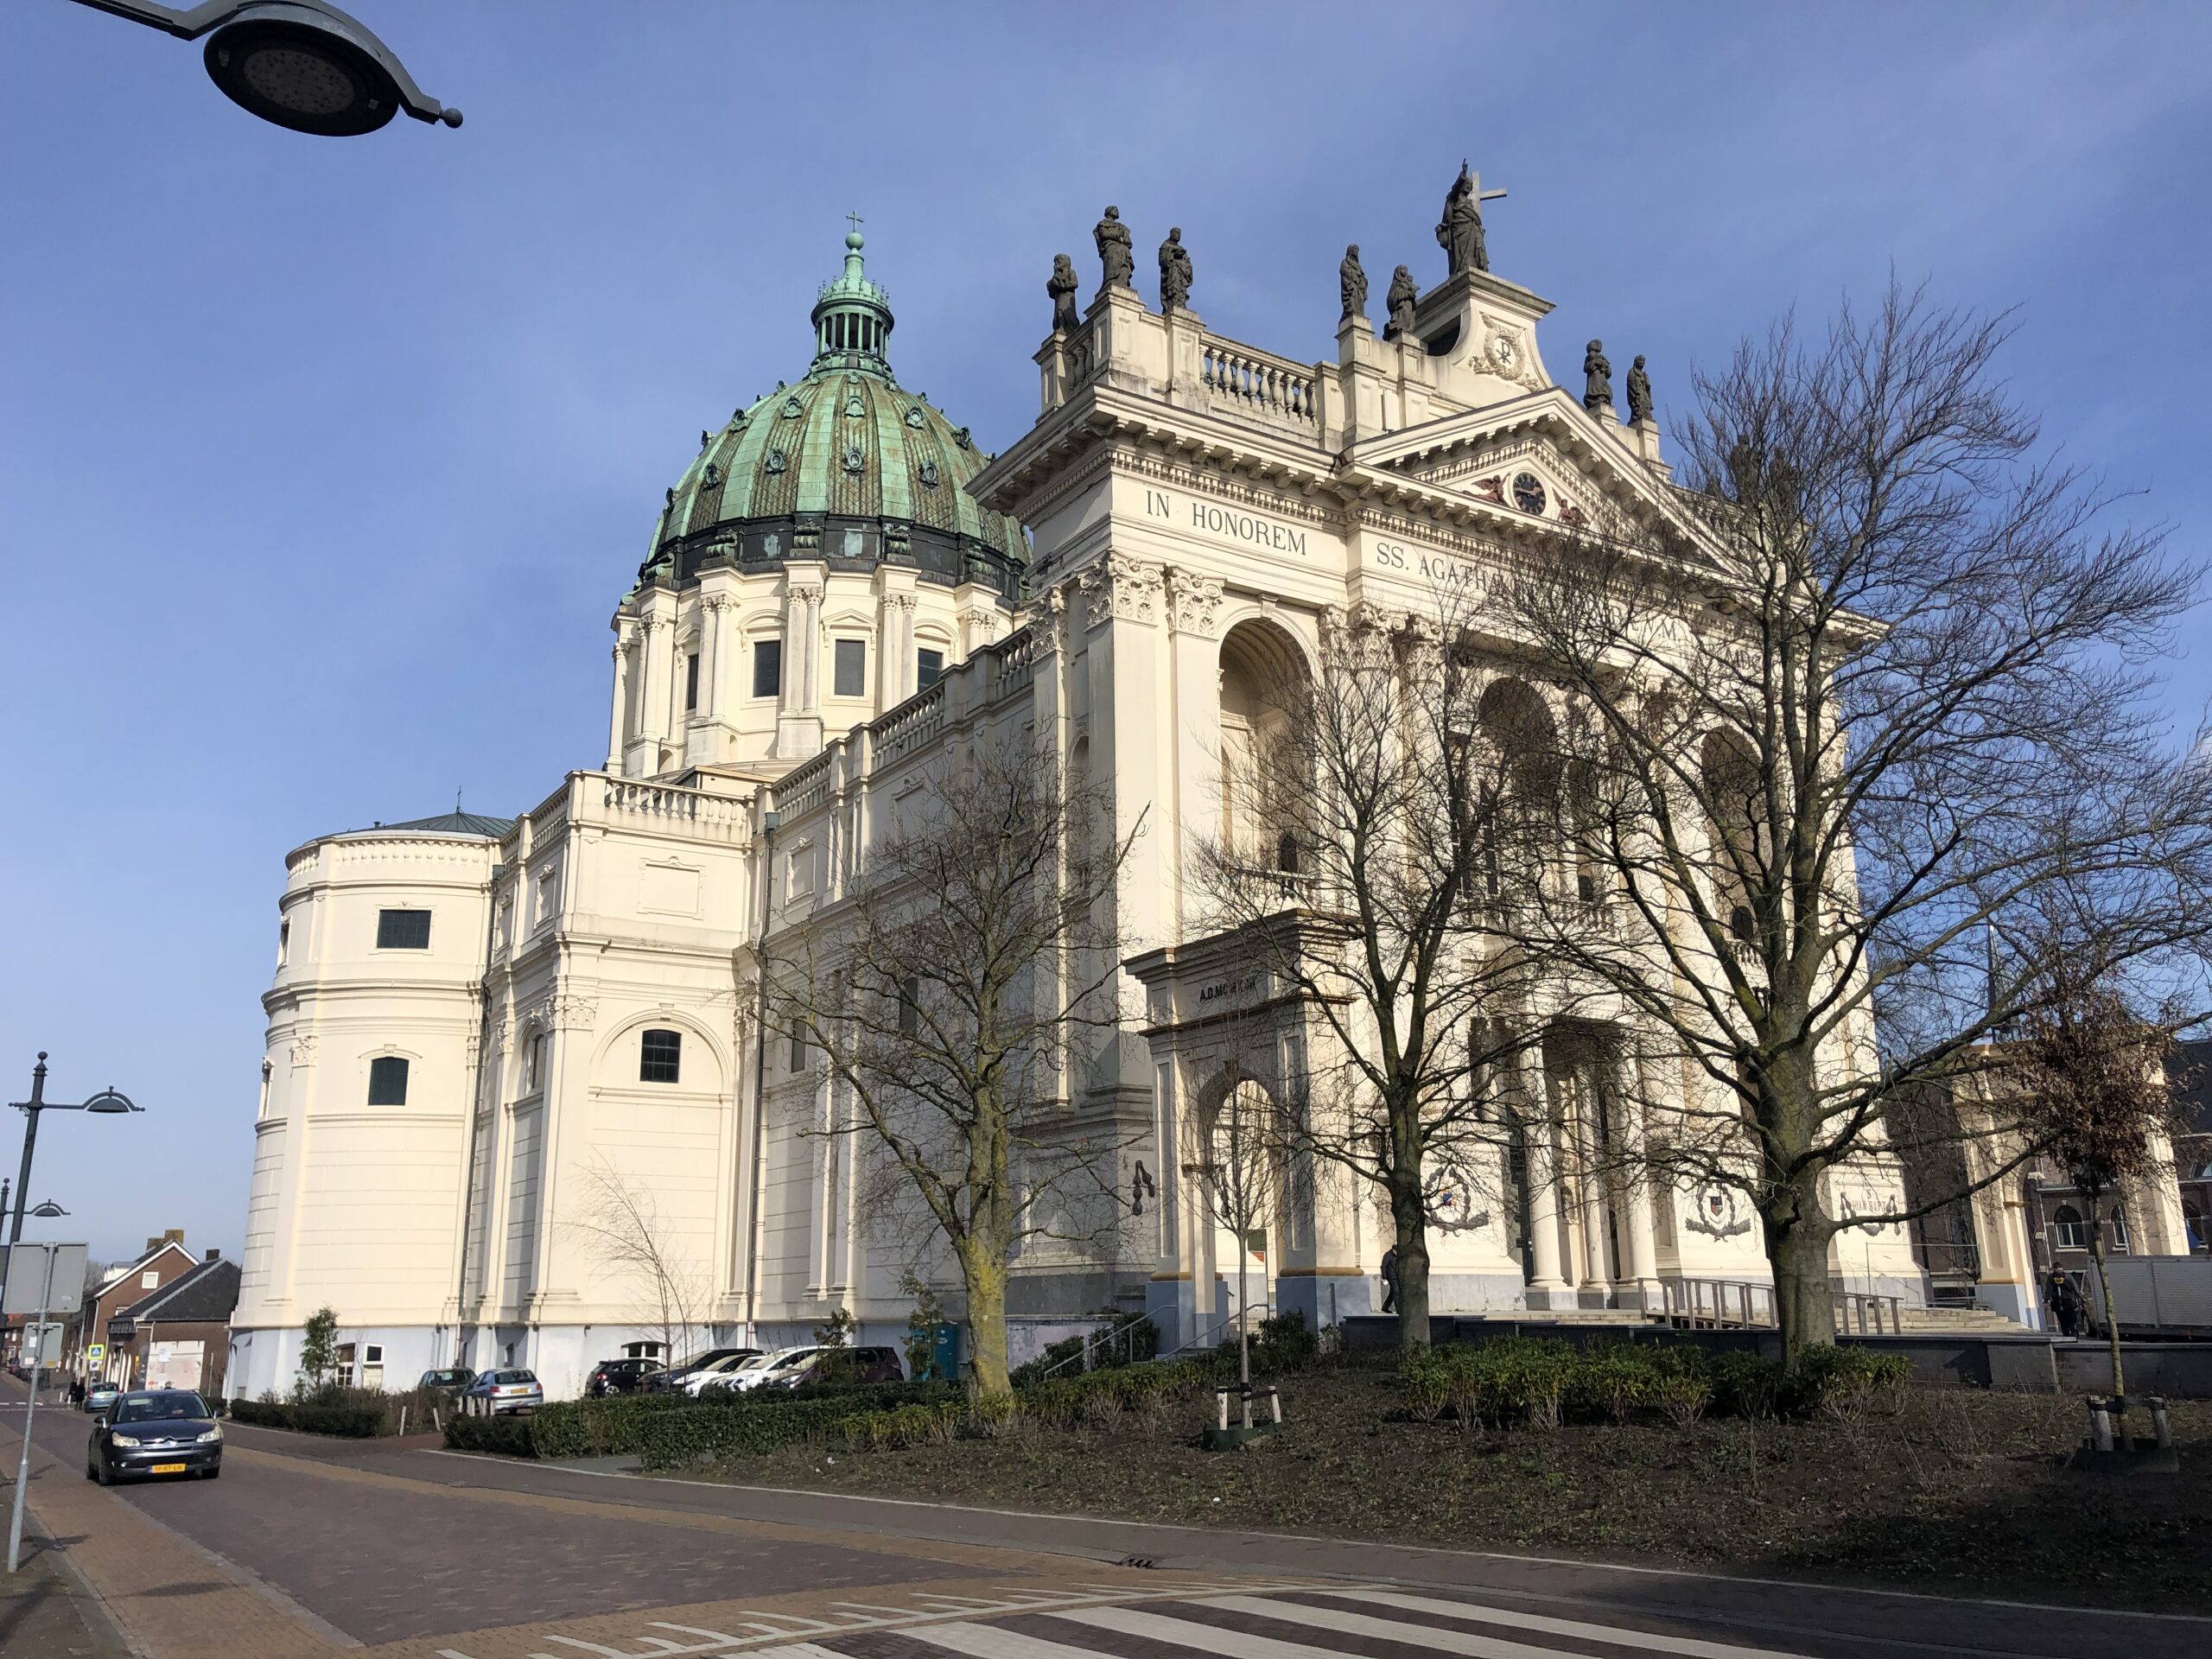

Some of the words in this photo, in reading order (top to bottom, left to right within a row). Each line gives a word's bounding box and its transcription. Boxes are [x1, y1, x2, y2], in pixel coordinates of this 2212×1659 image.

[1146, 490, 1170, 518] IN
[1192, 502, 1306, 556] HONOREM
[1376, 542, 1409, 570] SS.
[1419, 555, 1515, 599] AGATHA
